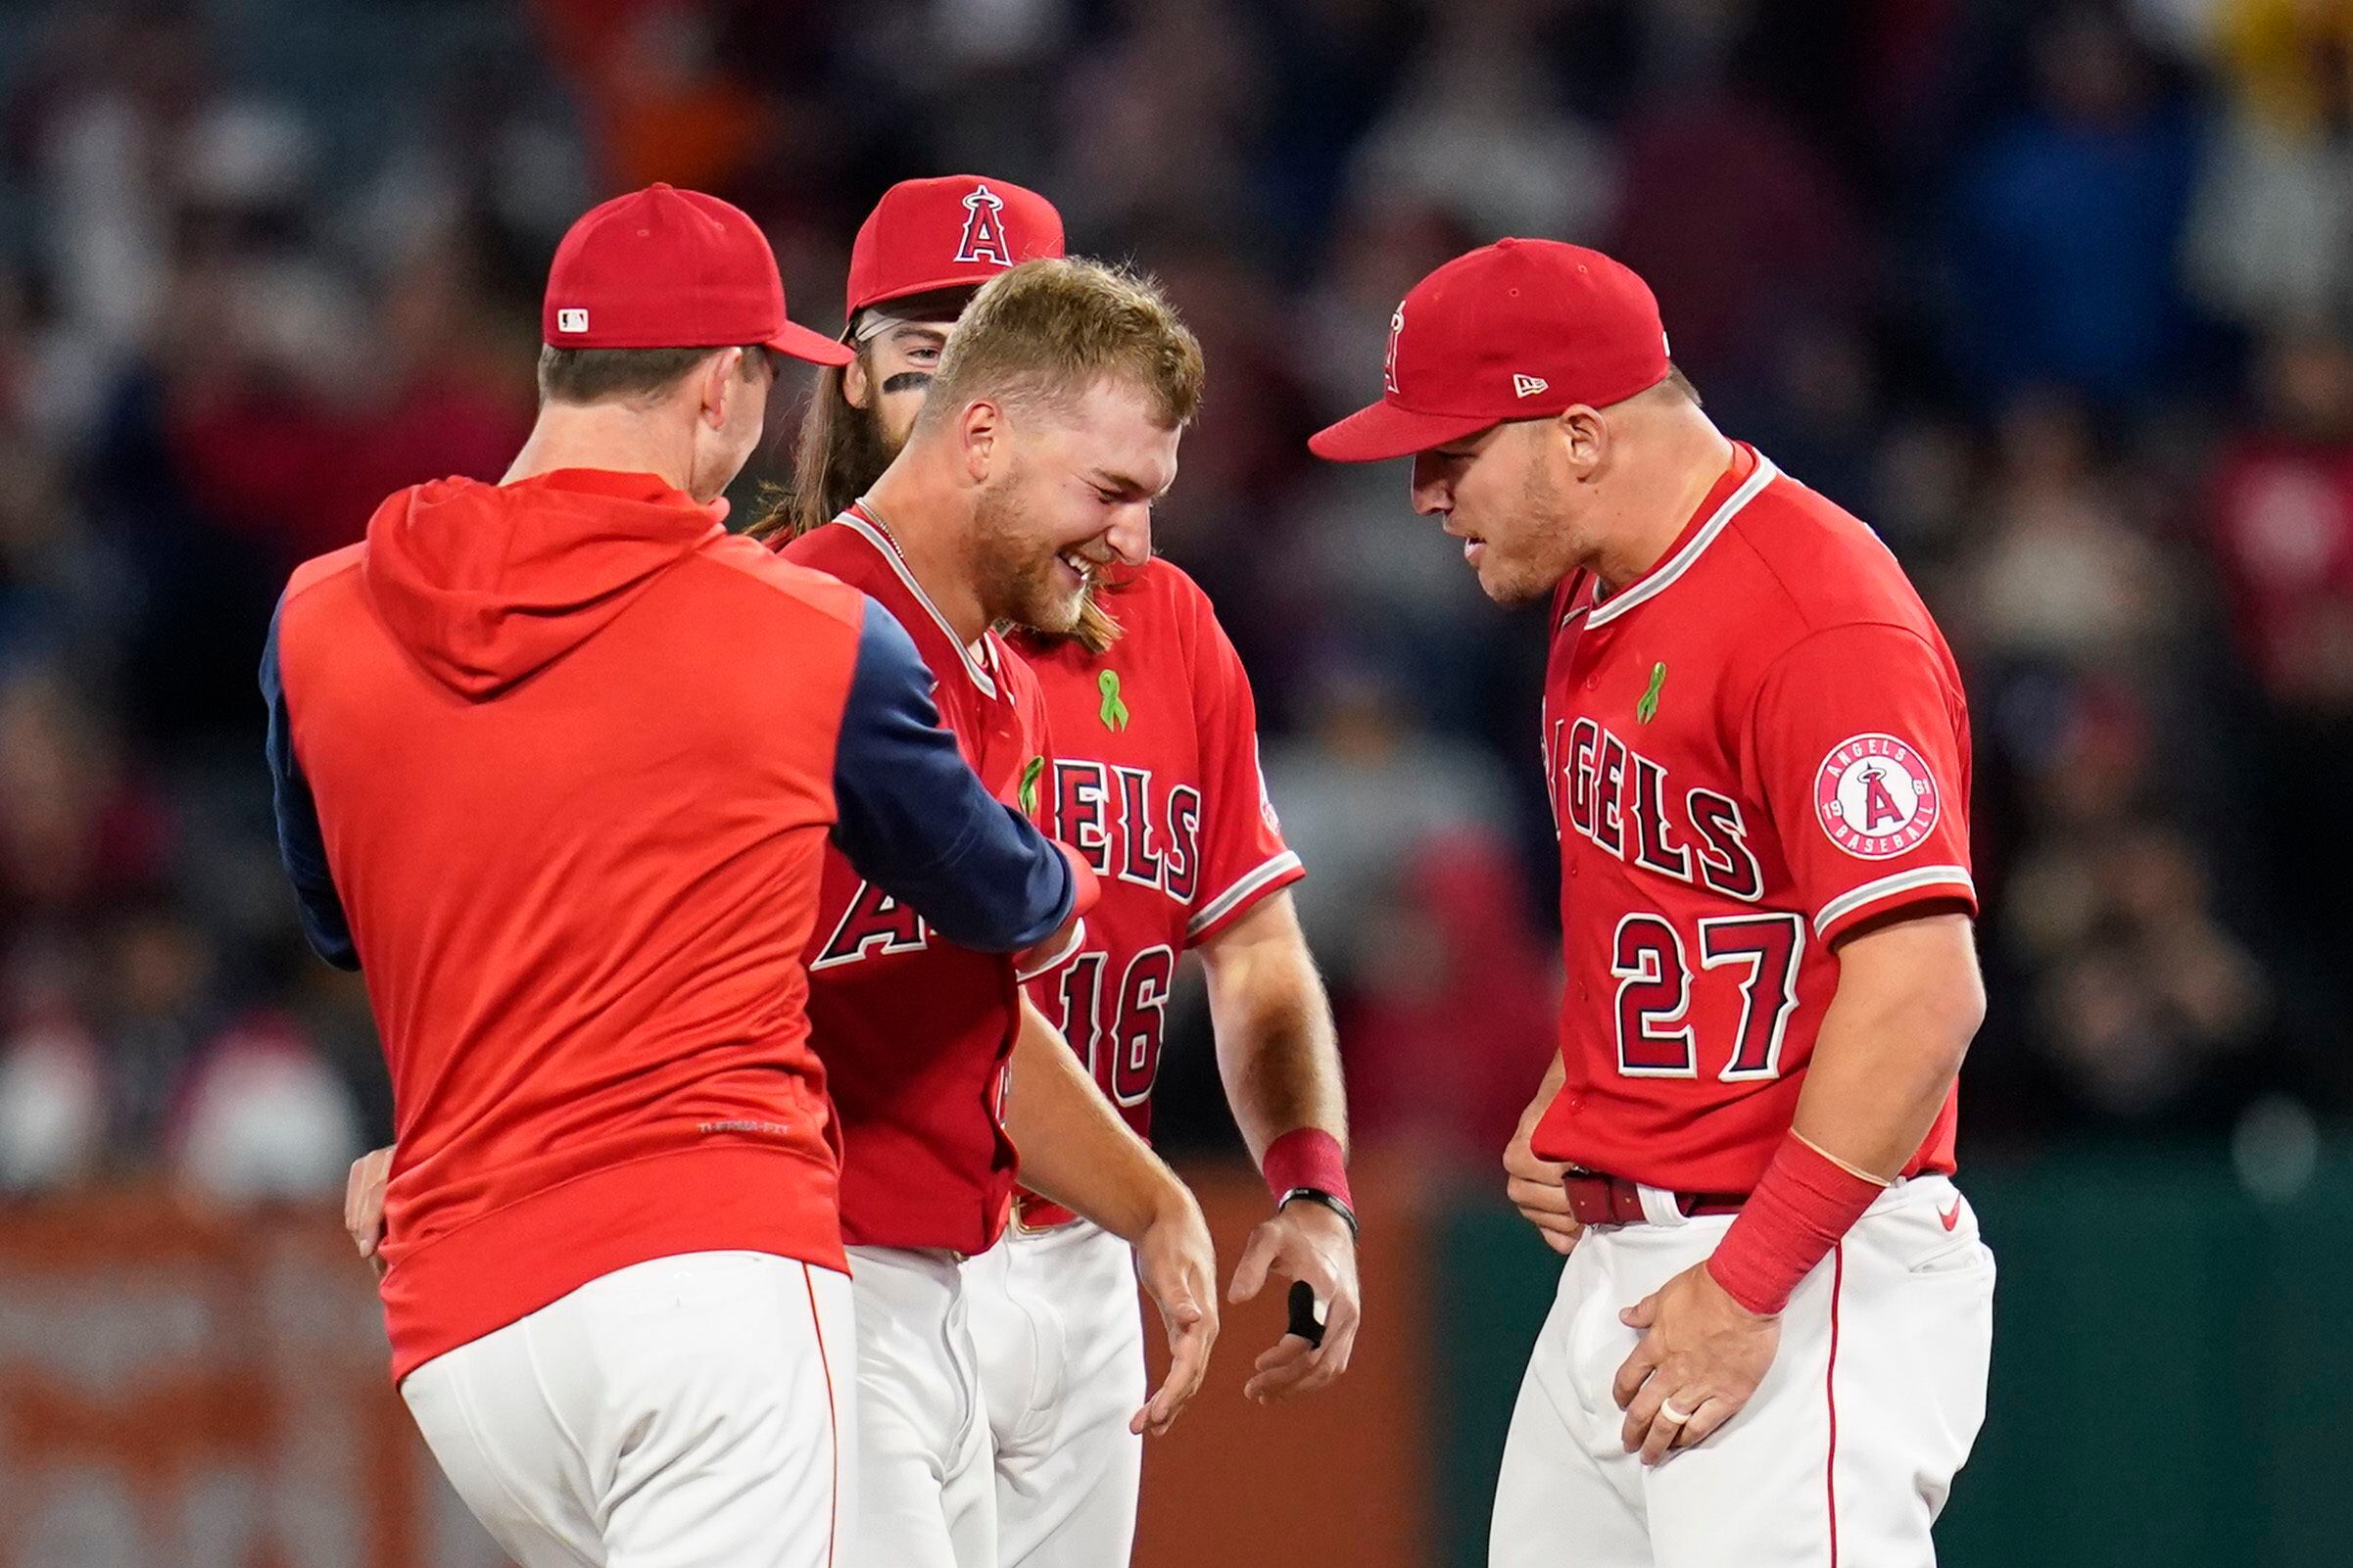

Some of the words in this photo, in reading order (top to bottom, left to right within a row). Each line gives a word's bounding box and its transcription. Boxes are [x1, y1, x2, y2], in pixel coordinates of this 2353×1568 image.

[953, 184, 1014, 266] A
[1826, 738, 1907, 778] ANGELS
[1912, 779, 1931, 794] 61
[1822, 799, 1843, 820] 19
[1857, 761, 1904, 831] A
[1835, 806, 1934, 853] BASEBALL
[1059, 943, 1174, 1108] 16
[1610, 912, 1806, 1082] 27
